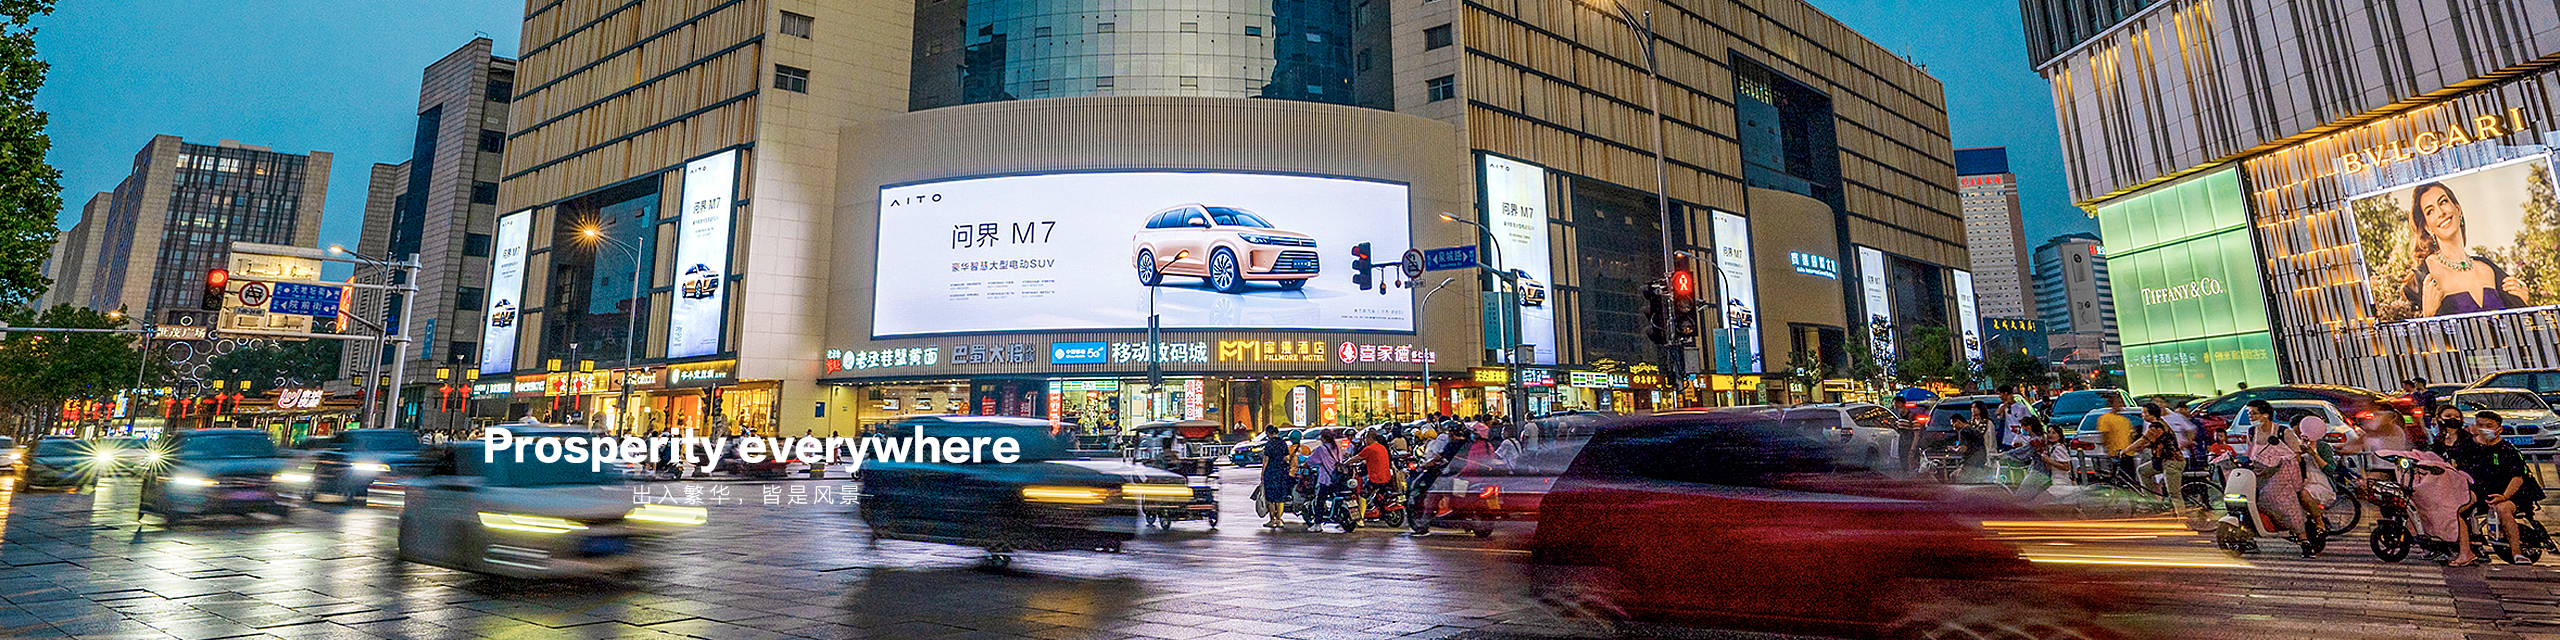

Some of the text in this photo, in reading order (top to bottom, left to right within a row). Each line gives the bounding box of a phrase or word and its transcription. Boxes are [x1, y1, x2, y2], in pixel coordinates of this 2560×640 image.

[2342, 107, 2525, 175] BVLGARI
[890, 194, 942, 207] AITO
[952, 221, 1056, 249] 问界 M7
[951, 259, 1055, 273] 豪华智慧大型电动SUV
[952, 343, 1024, 364] 巴蜀大将
[1111, 341, 1209, 363] 移动数码城
[1360, 344, 1410, 362] 喜家德
